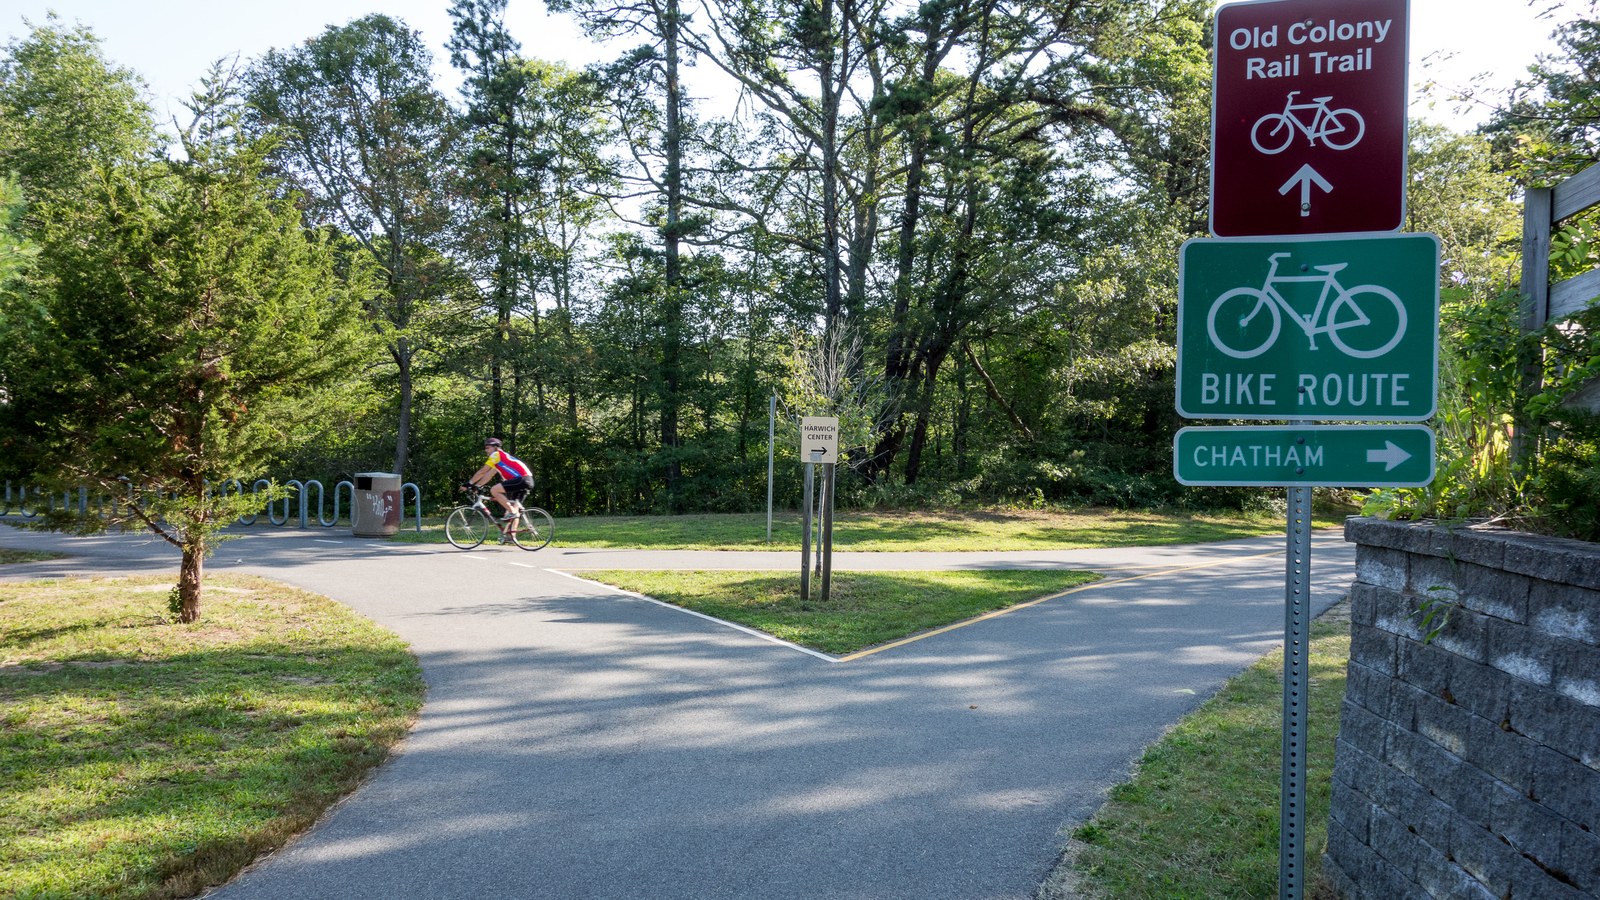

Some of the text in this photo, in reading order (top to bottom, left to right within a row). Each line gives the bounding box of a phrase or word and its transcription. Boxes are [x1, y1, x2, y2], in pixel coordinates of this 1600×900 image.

[1229, 19, 1392, 50] Old Colony
[1246, 48, 1372, 80] Rail Trail
[1201, 373, 1410, 406] BIKE ROUTE
[1194, 445, 1324, 467] CHATHAM
